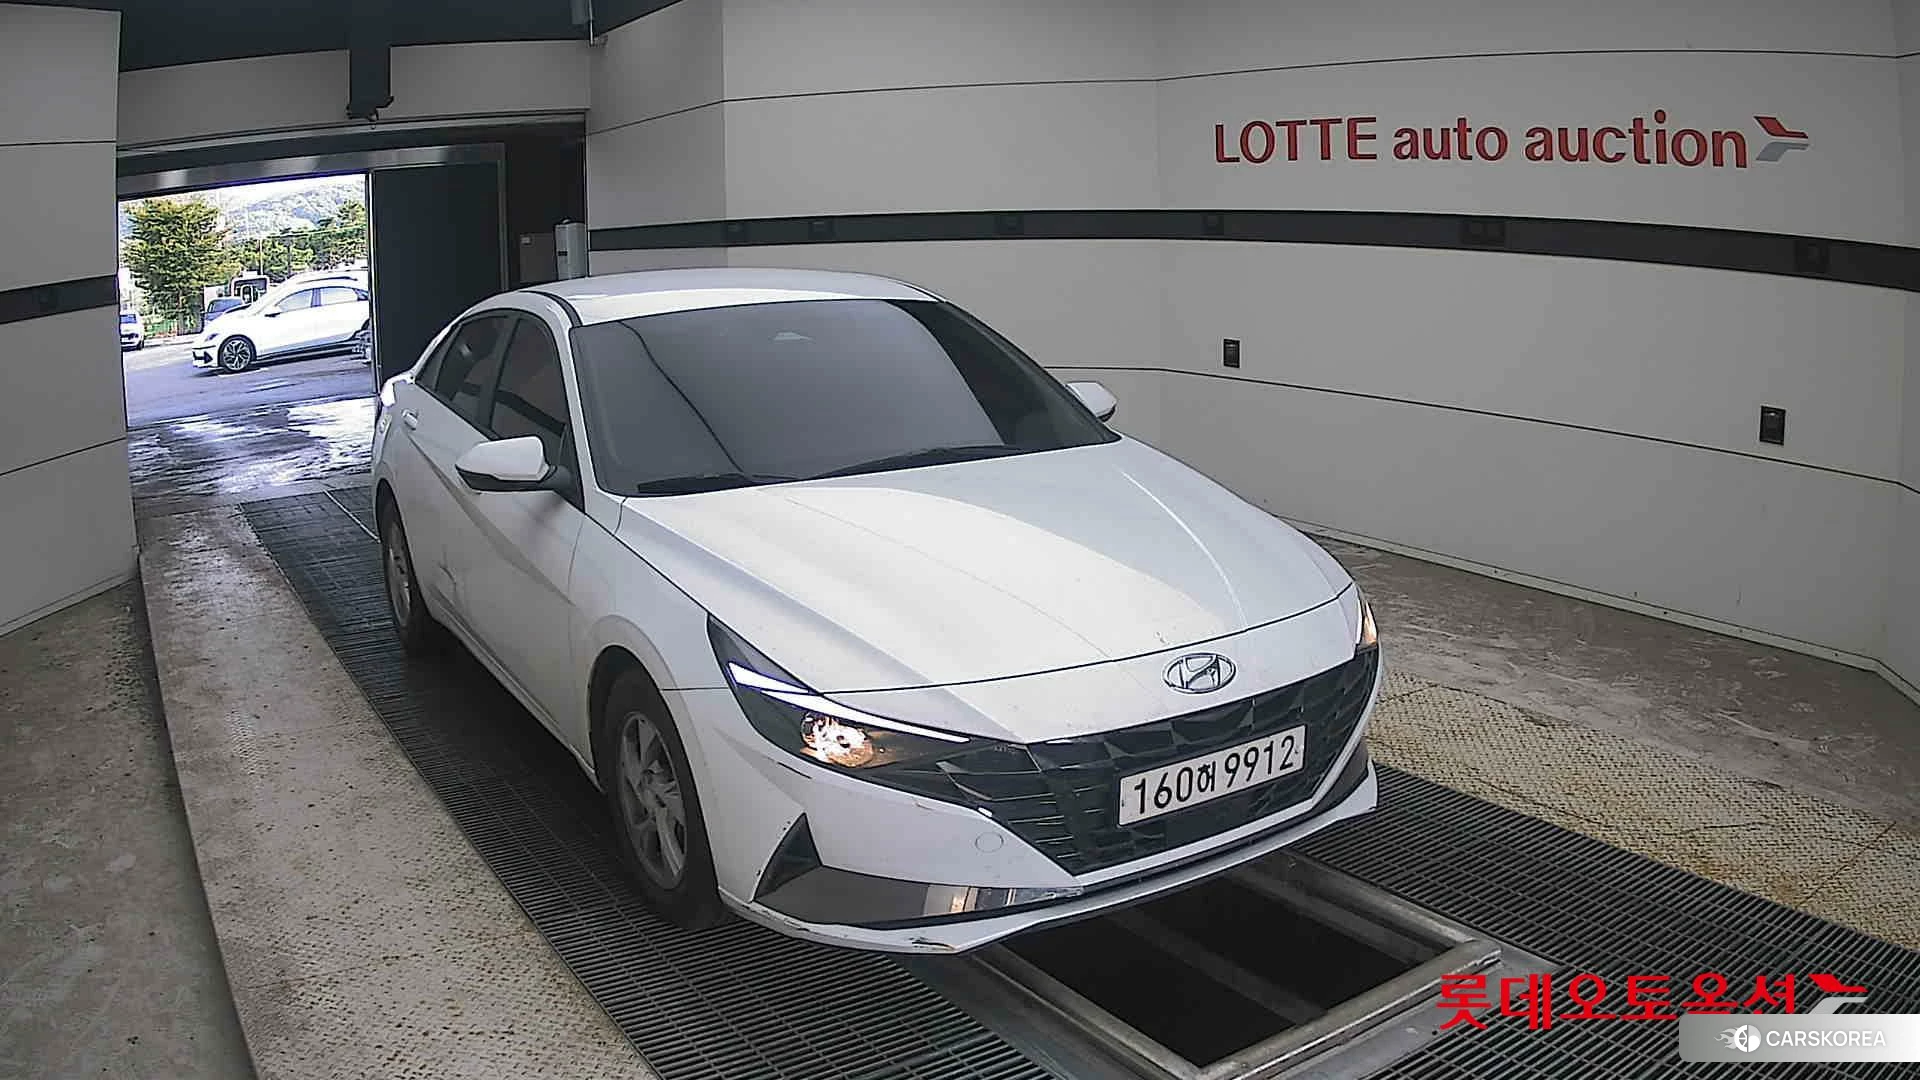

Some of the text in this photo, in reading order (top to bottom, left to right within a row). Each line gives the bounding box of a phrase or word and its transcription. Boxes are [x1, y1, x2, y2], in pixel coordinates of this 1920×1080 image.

[1215, 109, 1747, 168] LOTTE auto auction
